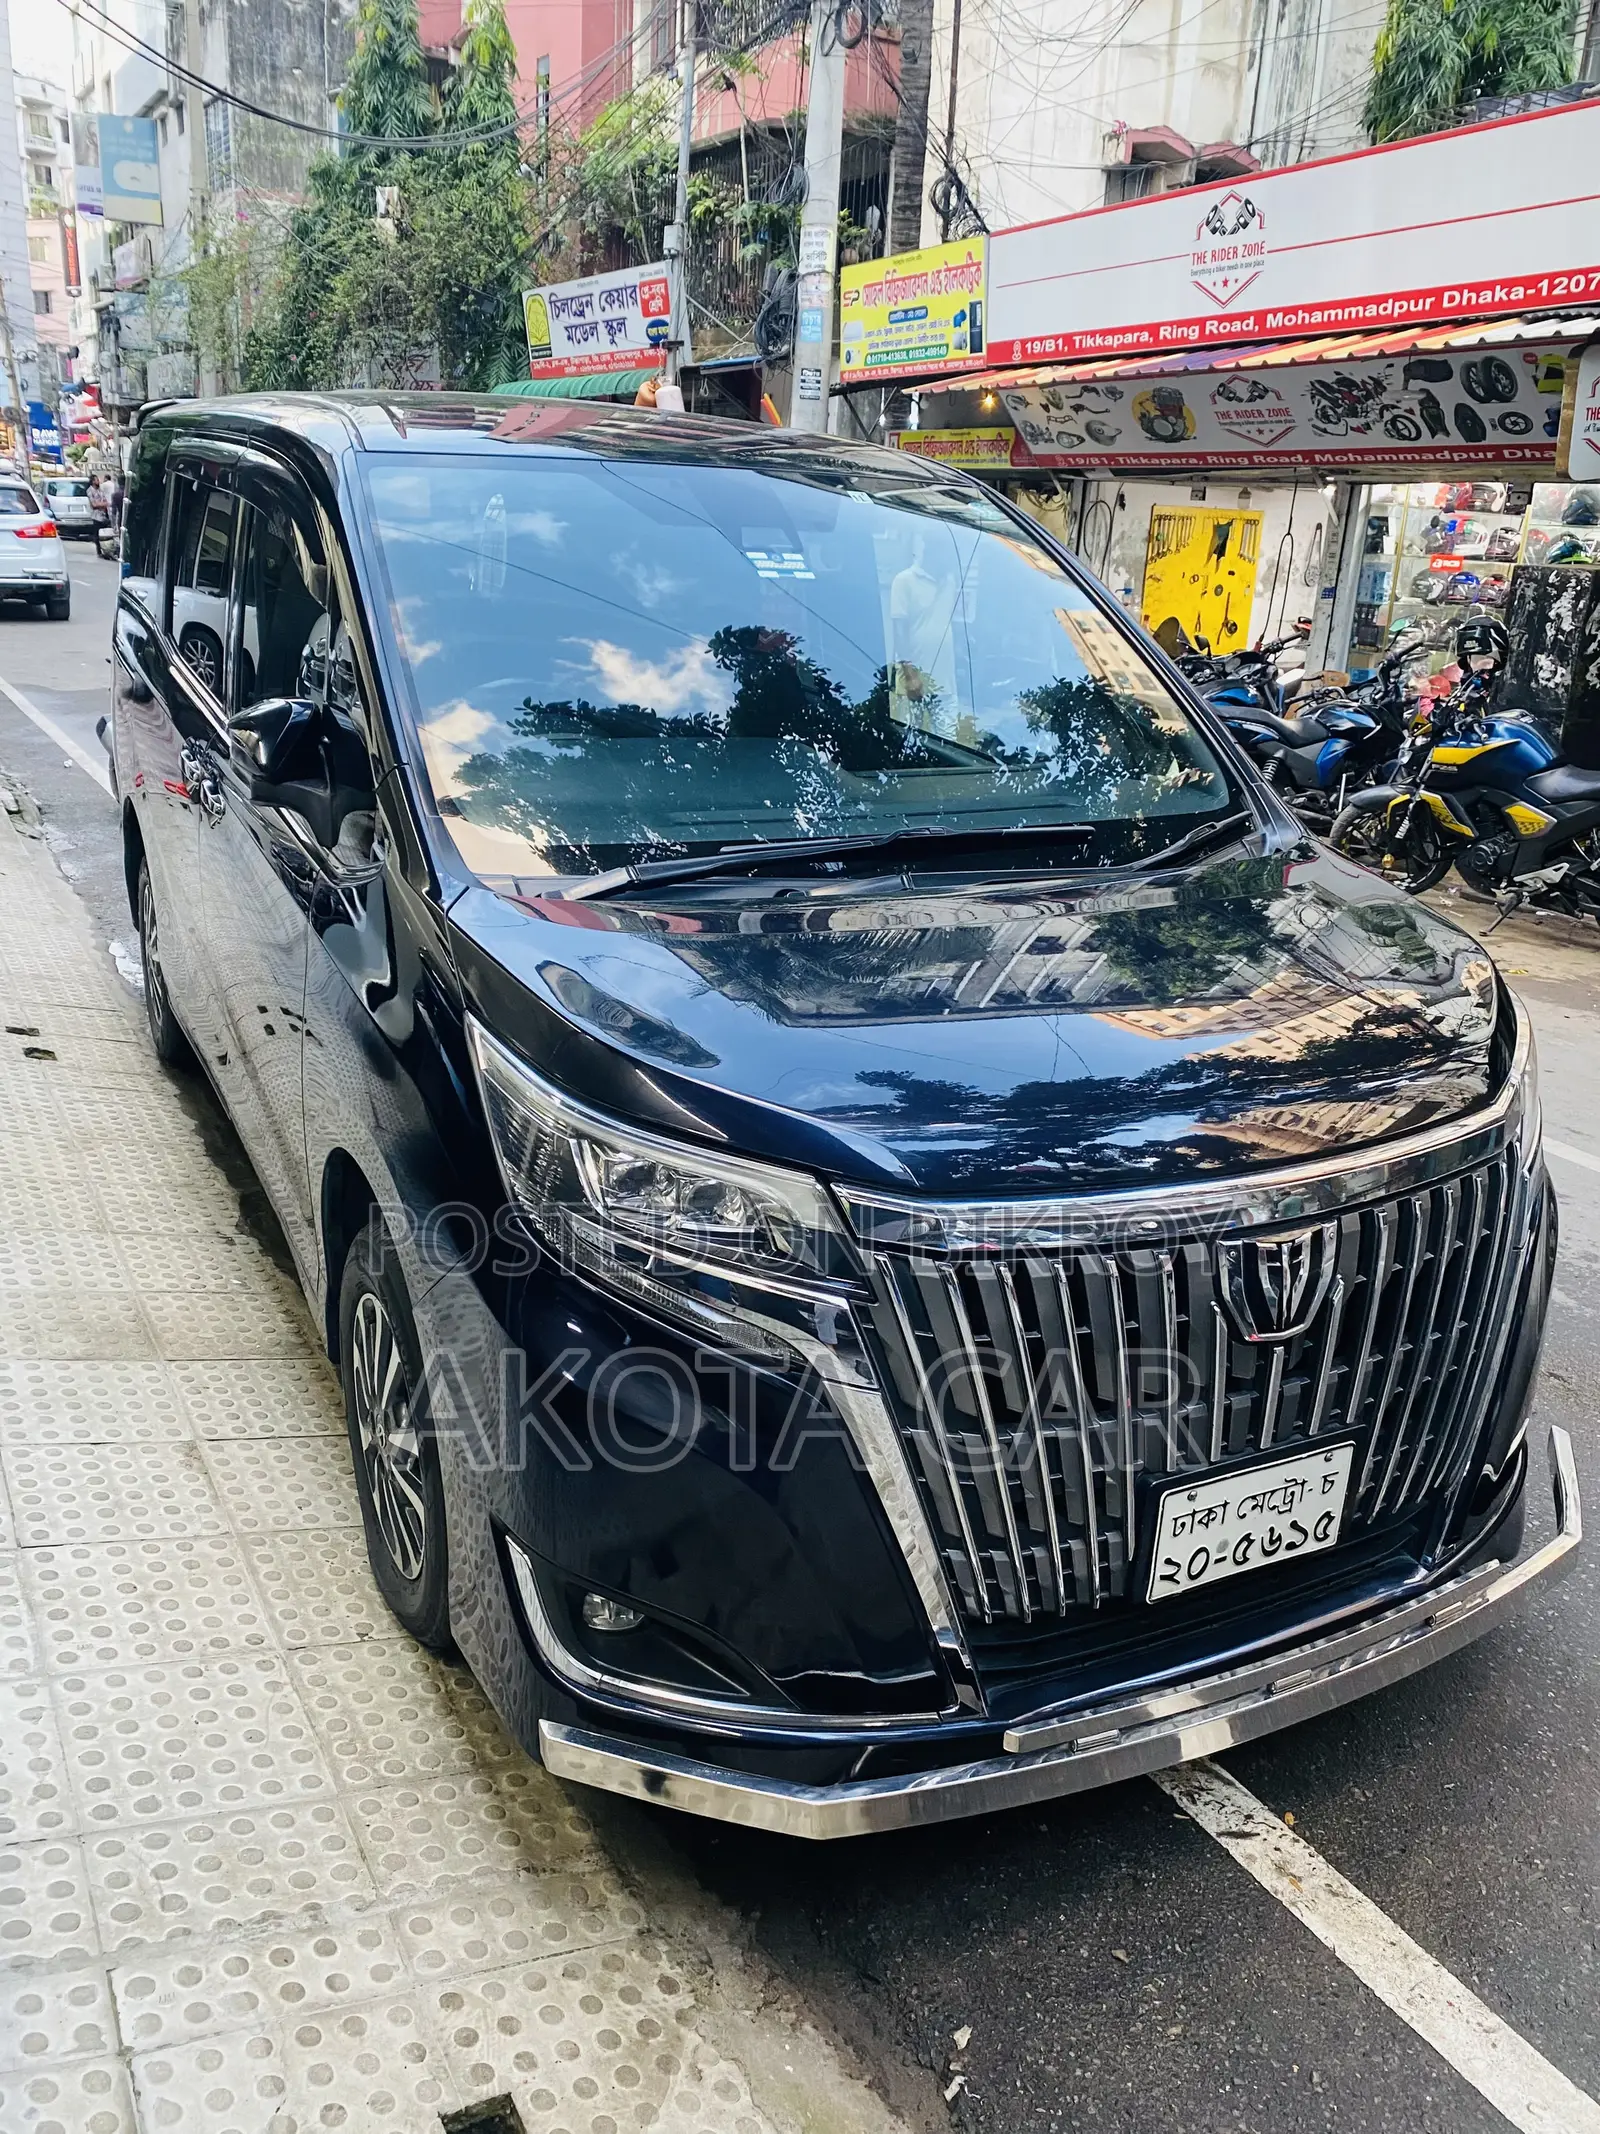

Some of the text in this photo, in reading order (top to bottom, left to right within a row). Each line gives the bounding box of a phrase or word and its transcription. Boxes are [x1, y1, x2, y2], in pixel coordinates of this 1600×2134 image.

[1192, 241, 1266, 266] THE RIDER ZONE
[548, 283, 639, 321] চিলড্রেন কেয়ার
[1025, 271, 1600, 354] 19/B1, Tikkapara, Ring Road, Mohammadpur Dhaka-1207
[564, 321, 600, 347] মডেল
[602, 317, 628, 347] স্কুল
[1214, 407, 1293, 421] THE RIDER ZONE
[1068, 456, 1115, 466] 19/B1,
[1117, 455, 1203, 466] Tikkapara,
[1207, 454, 1249, 466] Ring
[1253, 453, 1310, 465] Road,
[1314, 450, 1496, 464] Mohammadpur
[1172, 1499, 1231, 1537] ঢাকা
[1321, 1471, 1340, 1495] চ
[1159, 1510, 1336, 1585] ২০-৫৬১৫
